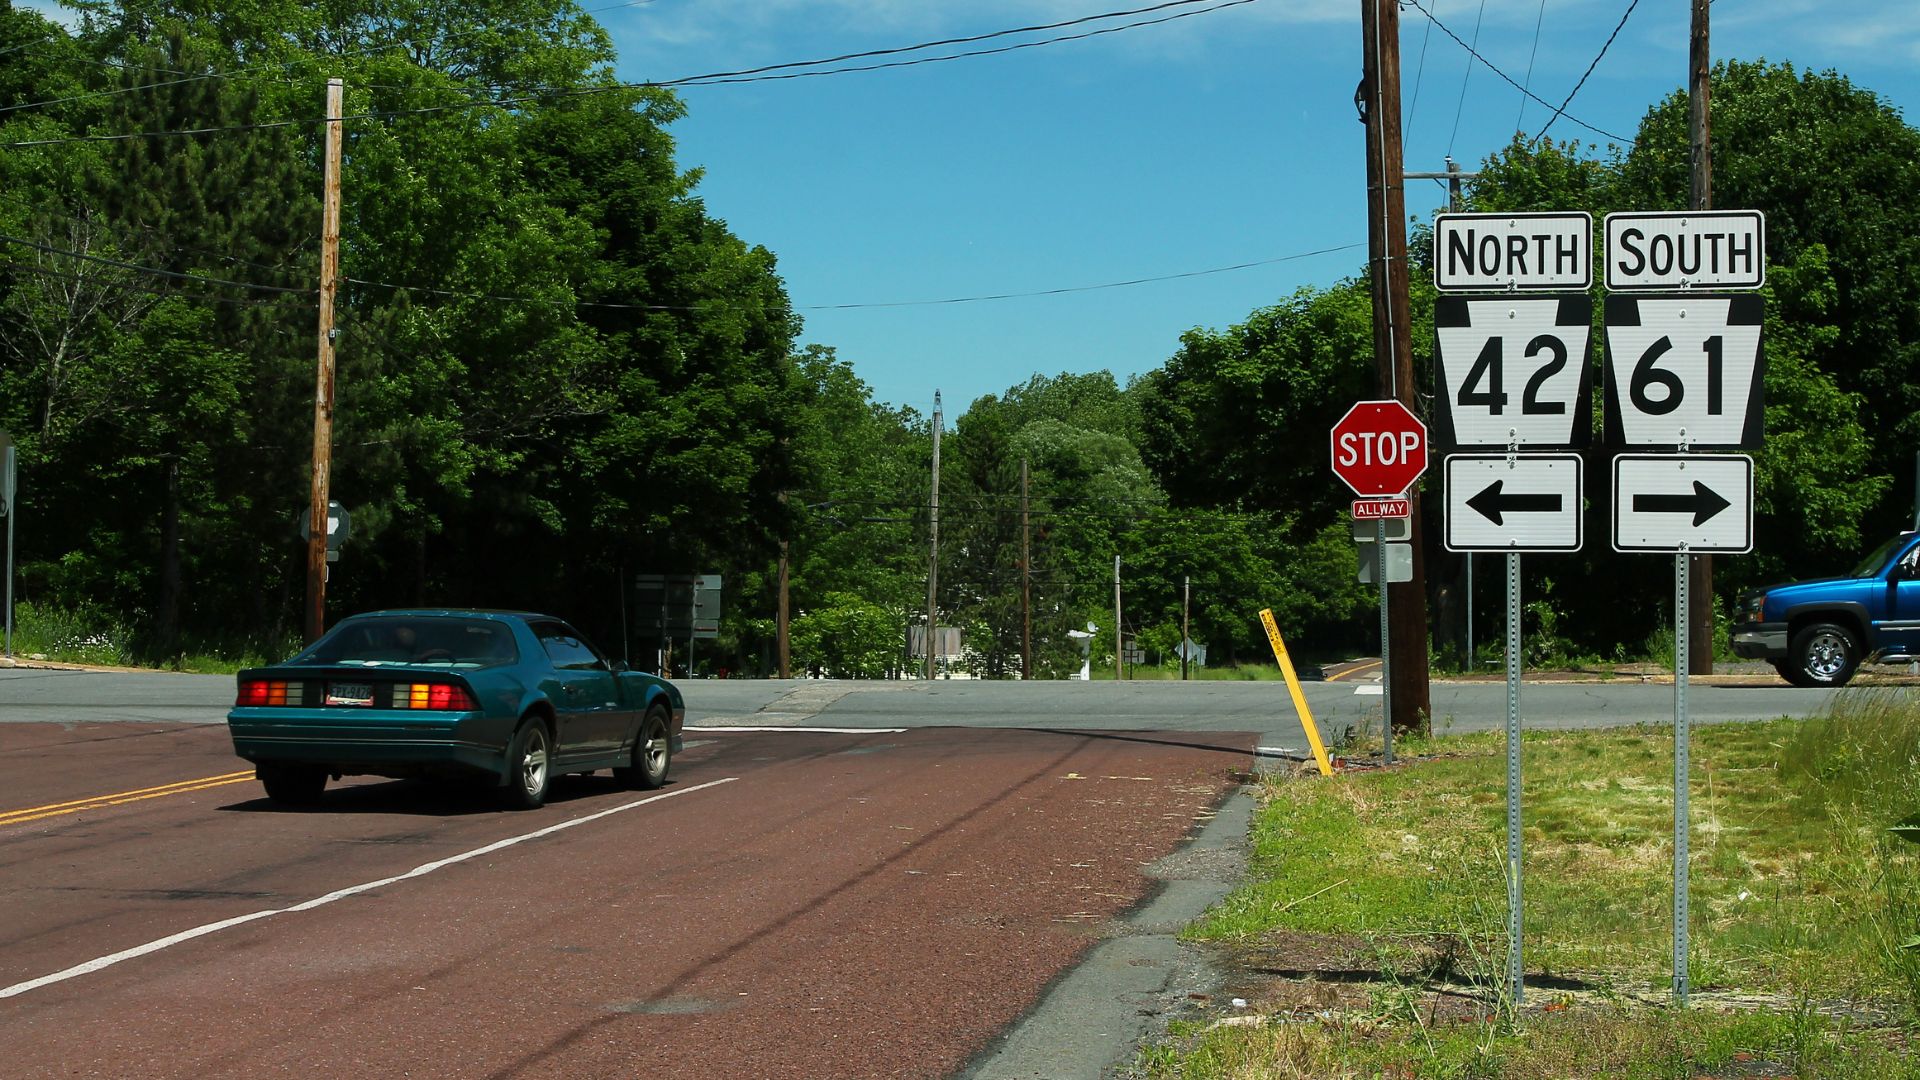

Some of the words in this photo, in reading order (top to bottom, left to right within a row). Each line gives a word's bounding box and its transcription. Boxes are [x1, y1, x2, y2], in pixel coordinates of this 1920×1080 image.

[1448, 229, 1578, 276] NORTH
[1618, 228, 1752, 276] SOUTH
[1458, 334, 1568, 415] 42
[1629, 335, 1723, 415] 61
[1339, 431, 1420, 466] STOP
